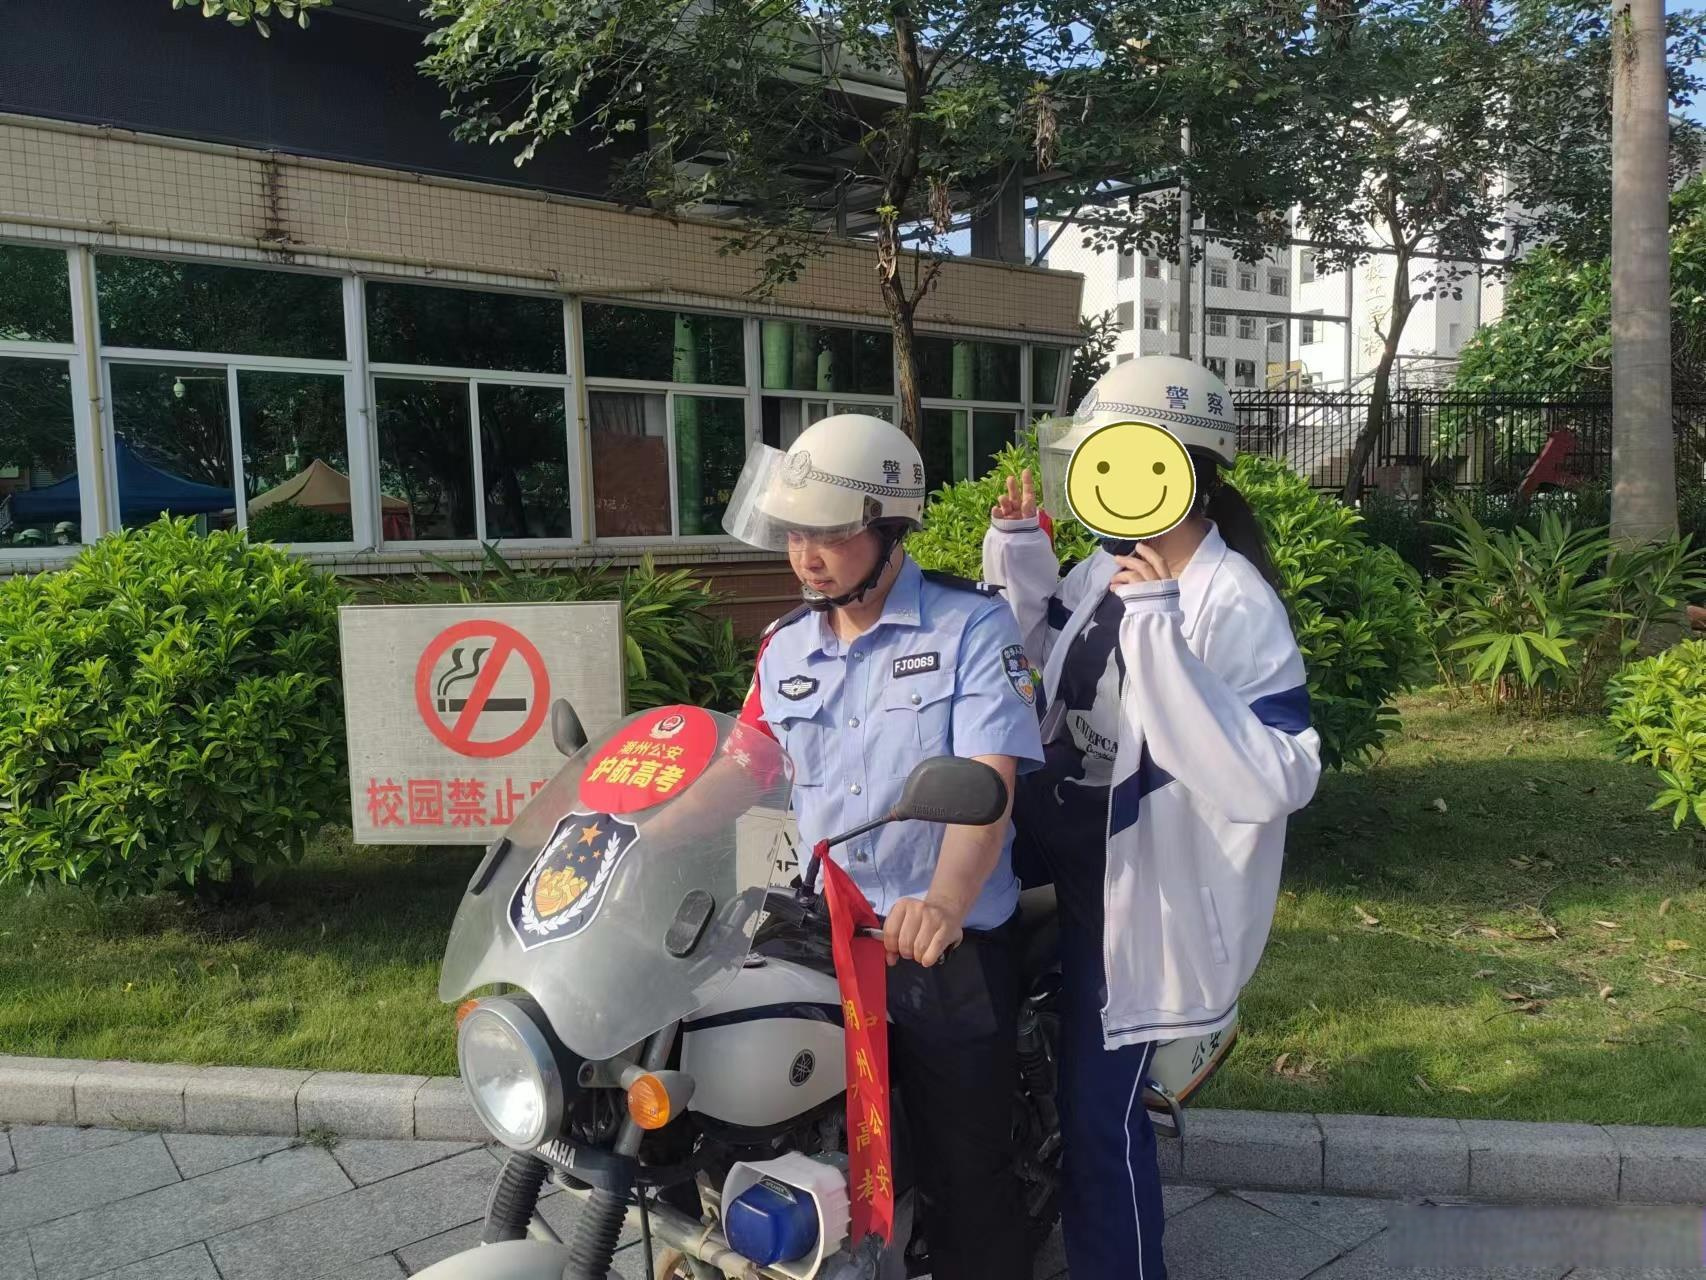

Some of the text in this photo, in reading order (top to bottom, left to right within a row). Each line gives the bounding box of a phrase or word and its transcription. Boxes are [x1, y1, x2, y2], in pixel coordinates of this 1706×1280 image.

[1166, 385, 1224, 417] 警察
[882, 460, 923, 485] 警察
[894, 655, 935, 673] FJ0069
[620, 740, 685, 762] 潮州公安
[587, 756, 686, 794] 护航高考
[366, 777, 549, 828] 校园禁止
